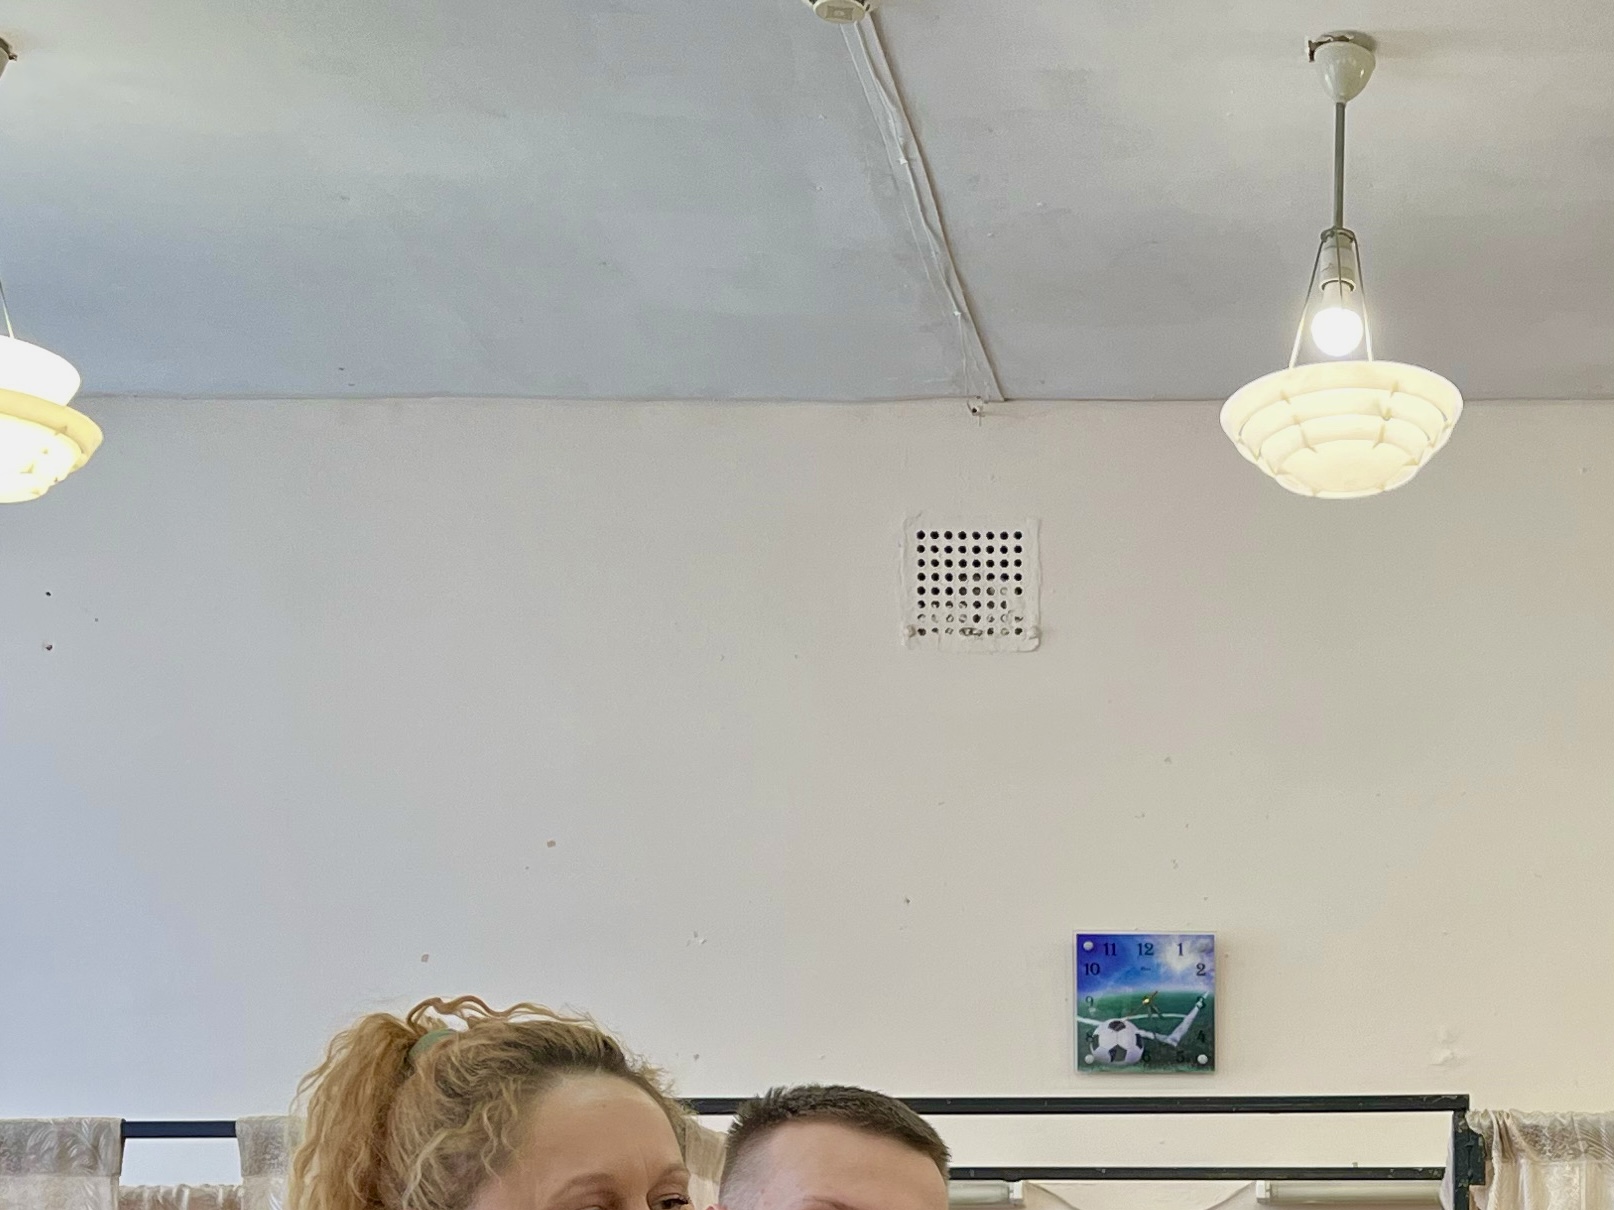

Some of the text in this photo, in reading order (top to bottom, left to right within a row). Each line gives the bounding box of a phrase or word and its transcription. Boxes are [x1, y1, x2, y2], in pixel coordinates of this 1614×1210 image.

[1104, 943, 1117, 956] 11
[1137, 942, 1154, 956] 12
[1178, 943, 1184, 956] 1
[1084, 963, 1100, 976] 10
[1196, 963, 1206, 976] 2
[1085, 995, 1094, 1008] 9
